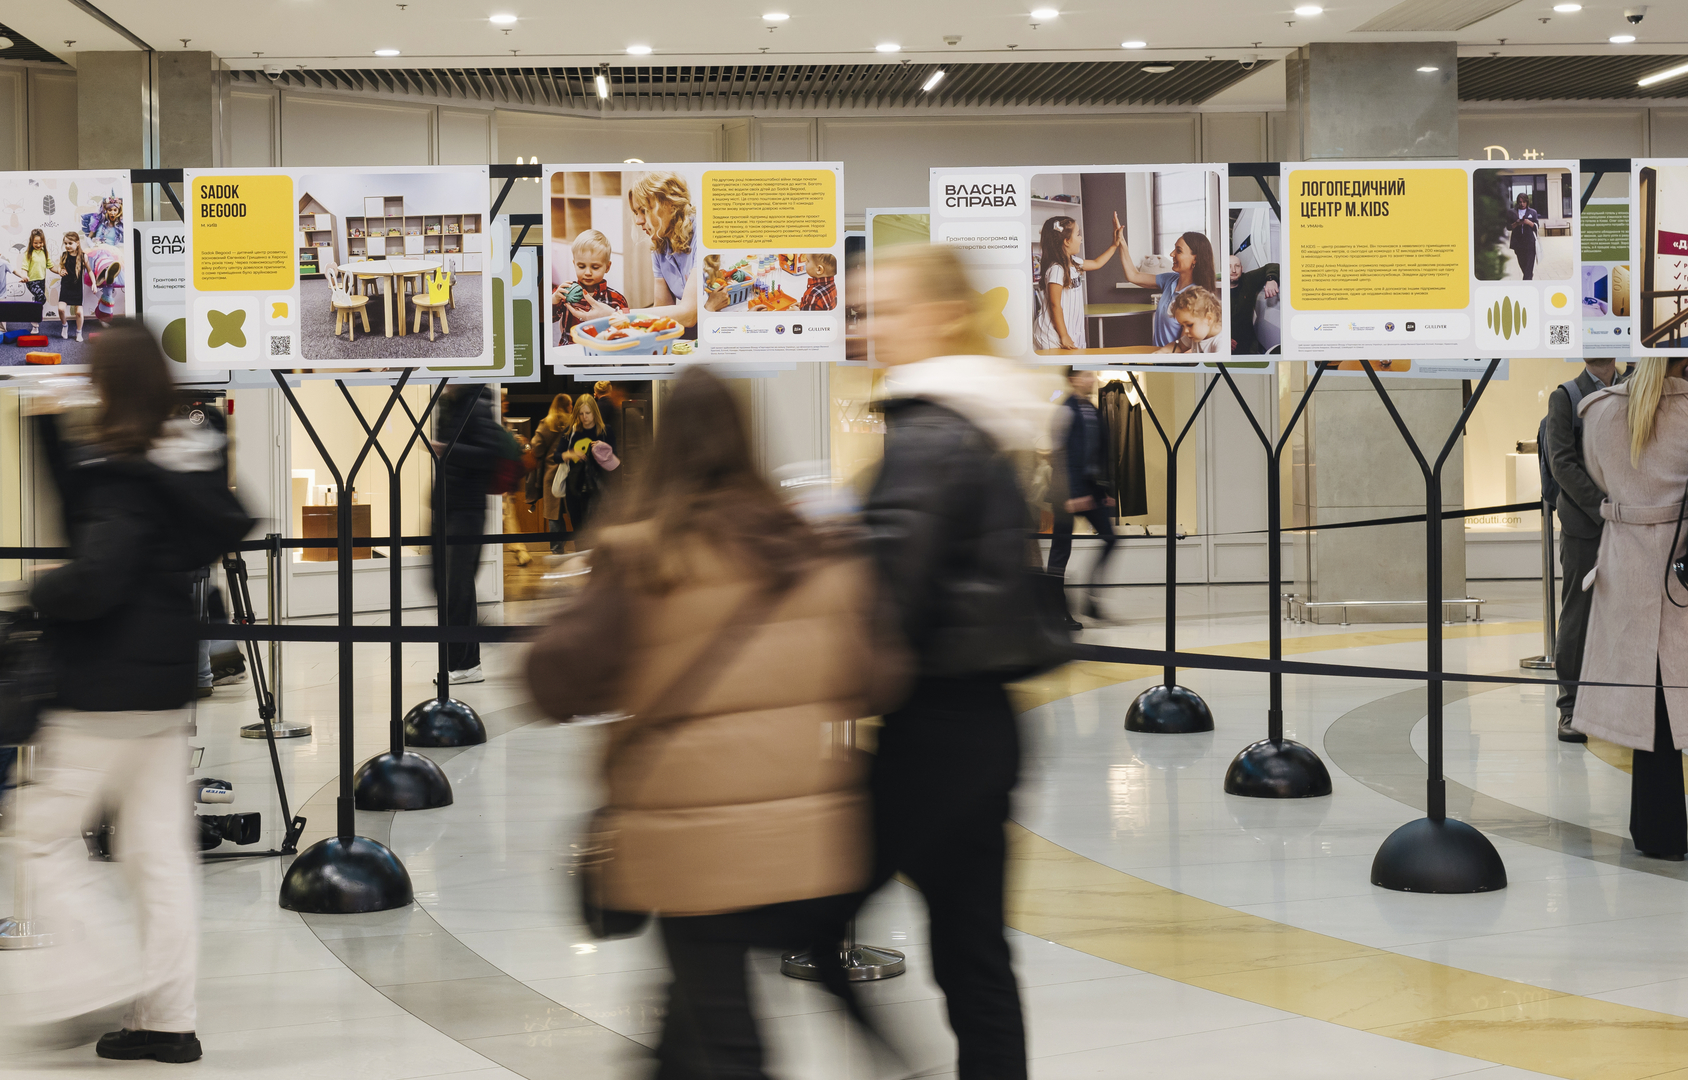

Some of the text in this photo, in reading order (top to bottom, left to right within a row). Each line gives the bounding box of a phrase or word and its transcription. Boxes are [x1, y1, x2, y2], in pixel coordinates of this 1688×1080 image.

[201, 185, 239, 199] SADOK
[945, 184, 1016, 195] ВЛАСНА
[1300, 178, 1405, 197] ЛОГОПЕДИЧНИЙ
[945, 196, 1017, 207] СПРАВА
[201, 203, 246, 217] BEGOOD
[1301, 202, 1389, 218] ЦЕНТР M.KIDS
